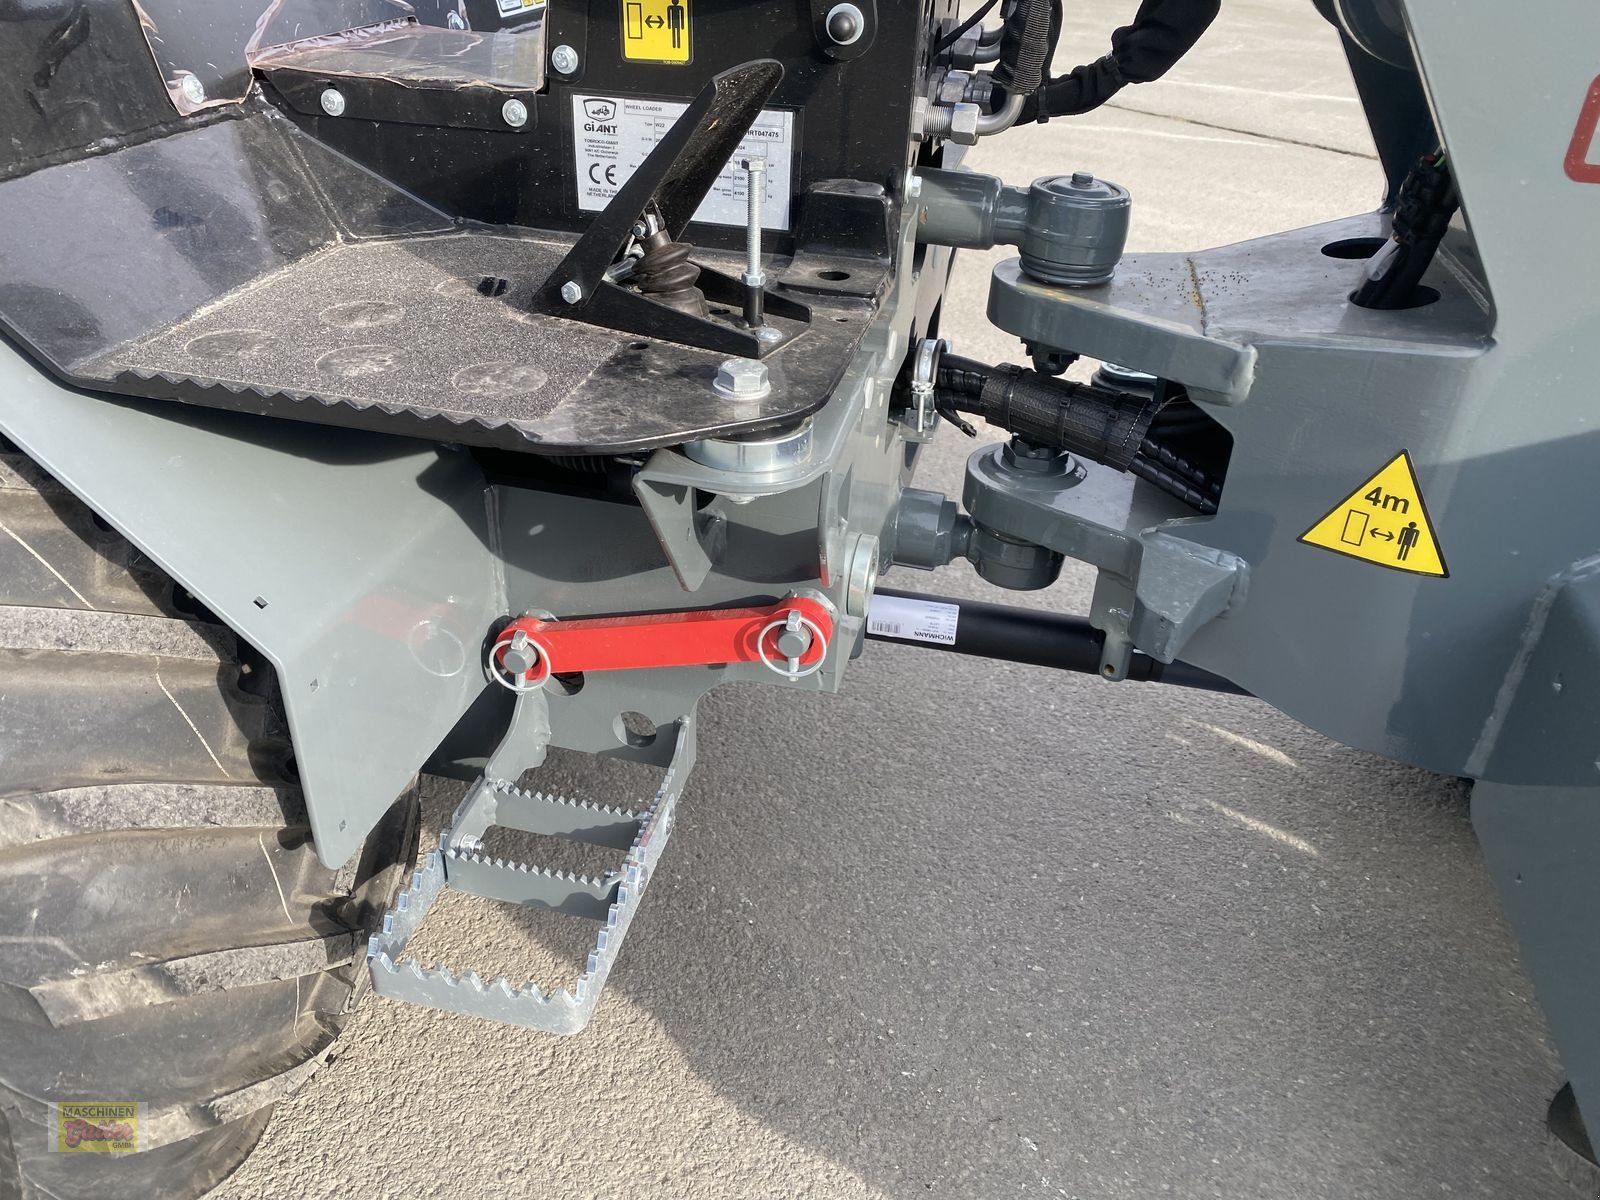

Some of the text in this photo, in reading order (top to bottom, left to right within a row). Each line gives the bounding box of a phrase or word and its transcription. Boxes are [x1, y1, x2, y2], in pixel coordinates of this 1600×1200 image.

[589, 163, 617, 186] CE
[1364, 486, 1410, 514] 4m
[914, 631, 954, 641] WICHMANN
